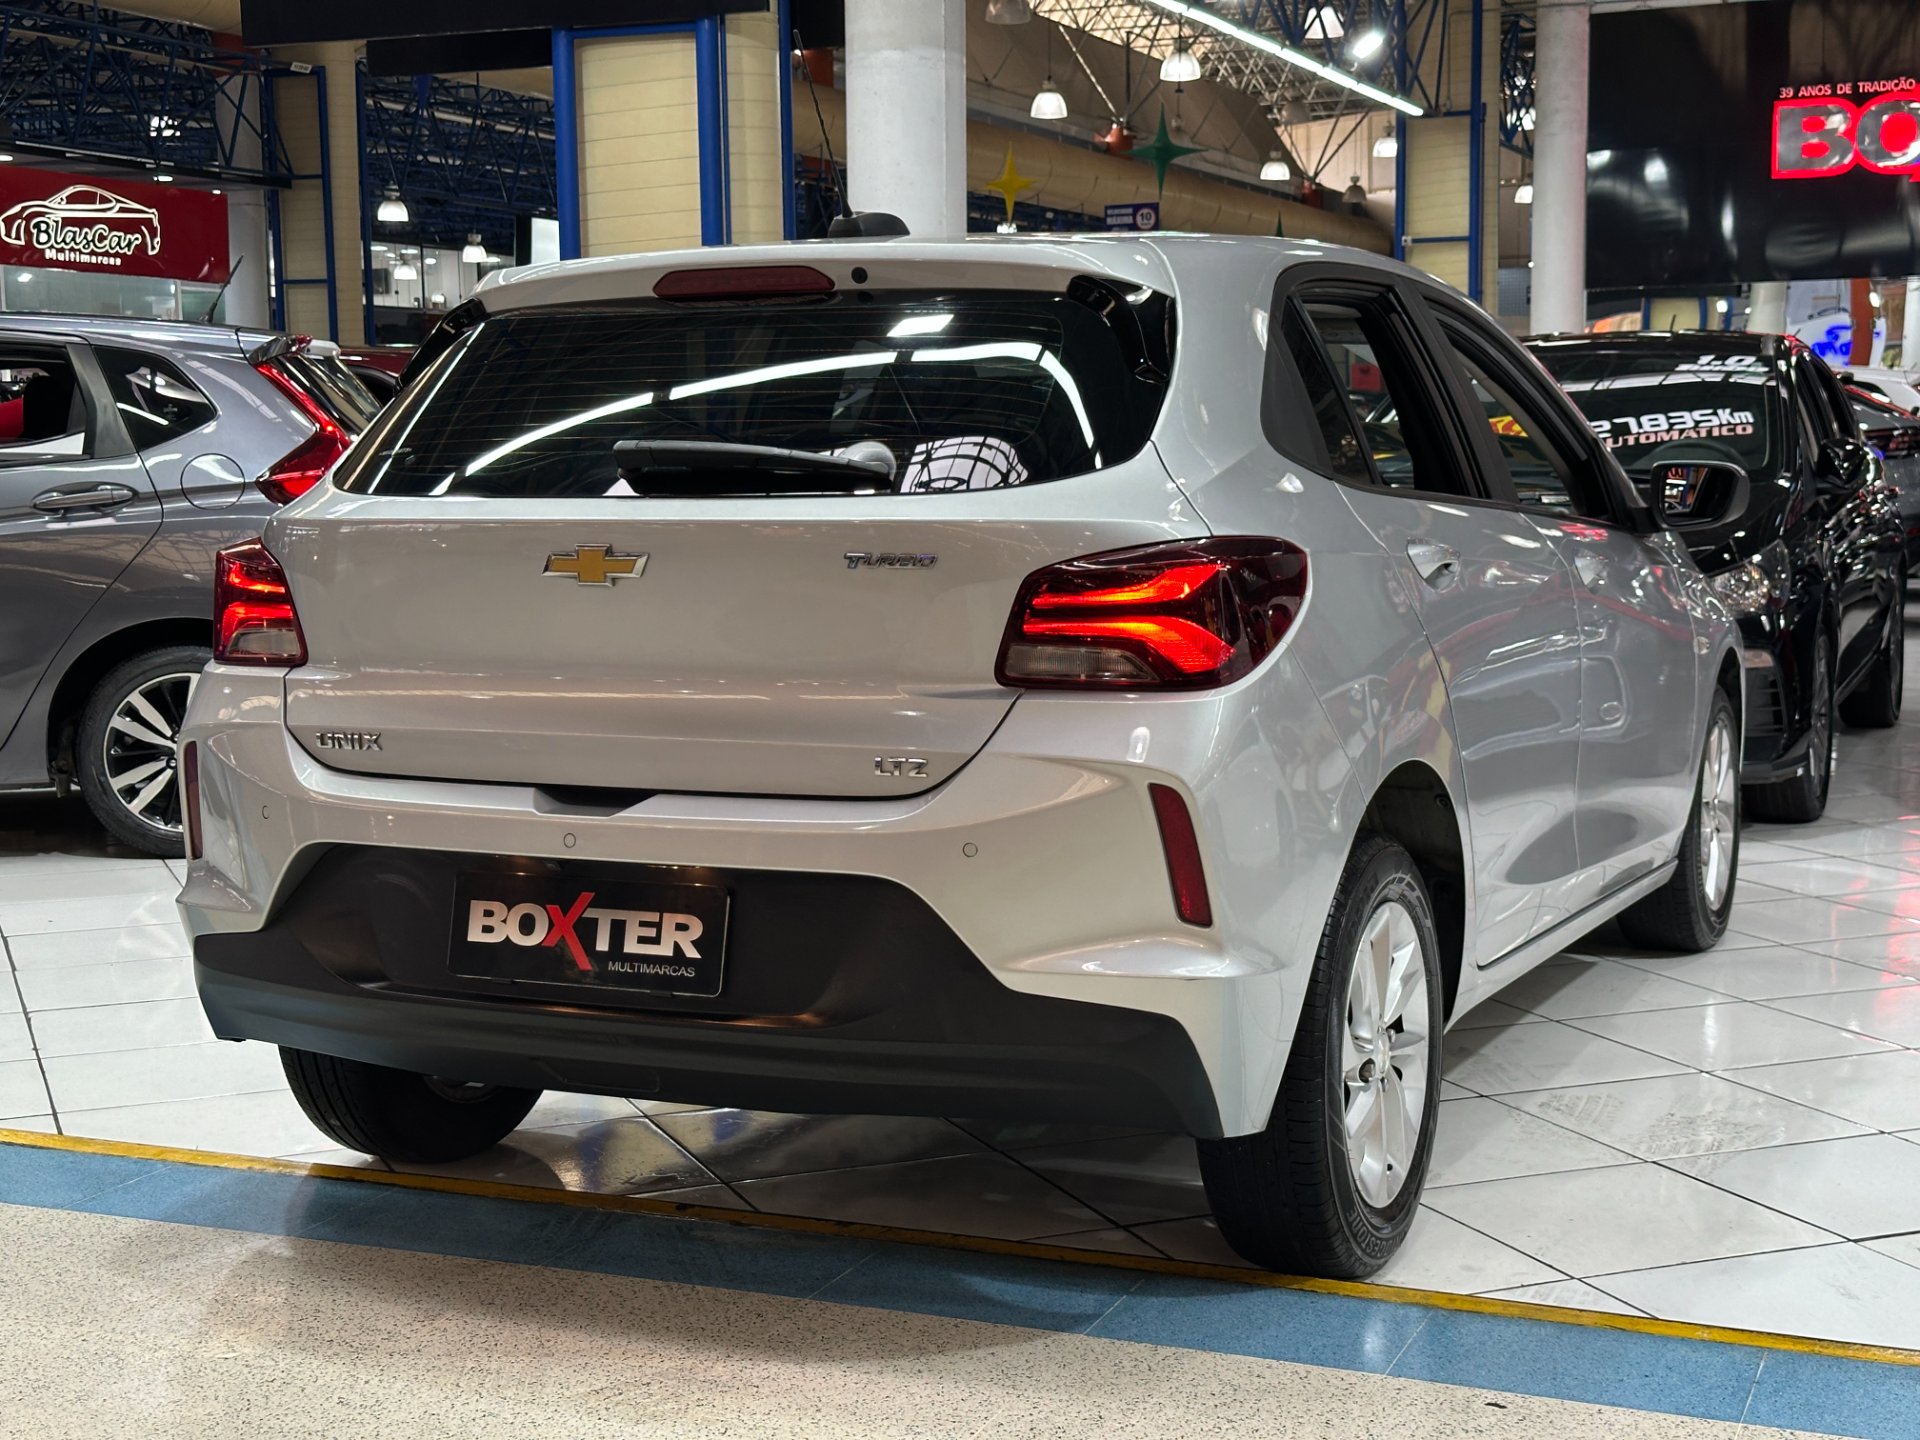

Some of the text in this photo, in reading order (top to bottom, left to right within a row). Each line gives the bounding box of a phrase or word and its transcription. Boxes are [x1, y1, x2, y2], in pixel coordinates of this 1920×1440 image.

[1779, 77, 1916, 98] 39 ANOS DE TRADIÇÃO
[1771, 97, 1920, 182] BO
[1139, 211, 1153, 222] 10
[30, 216, 142, 255] BlasCar
[45, 250, 122, 266] Multimarcas
[1697, 355, 1757, 367] 1.0
[1604, 424, 1754, 448] UTOMATICO
[843, 552, 938, 569] TURBO
[874, 757, 928, 778] LTZ
[467, 891, 704, 971] BOXTER
[608, 961, 695, 977] MULTIMARCAS
